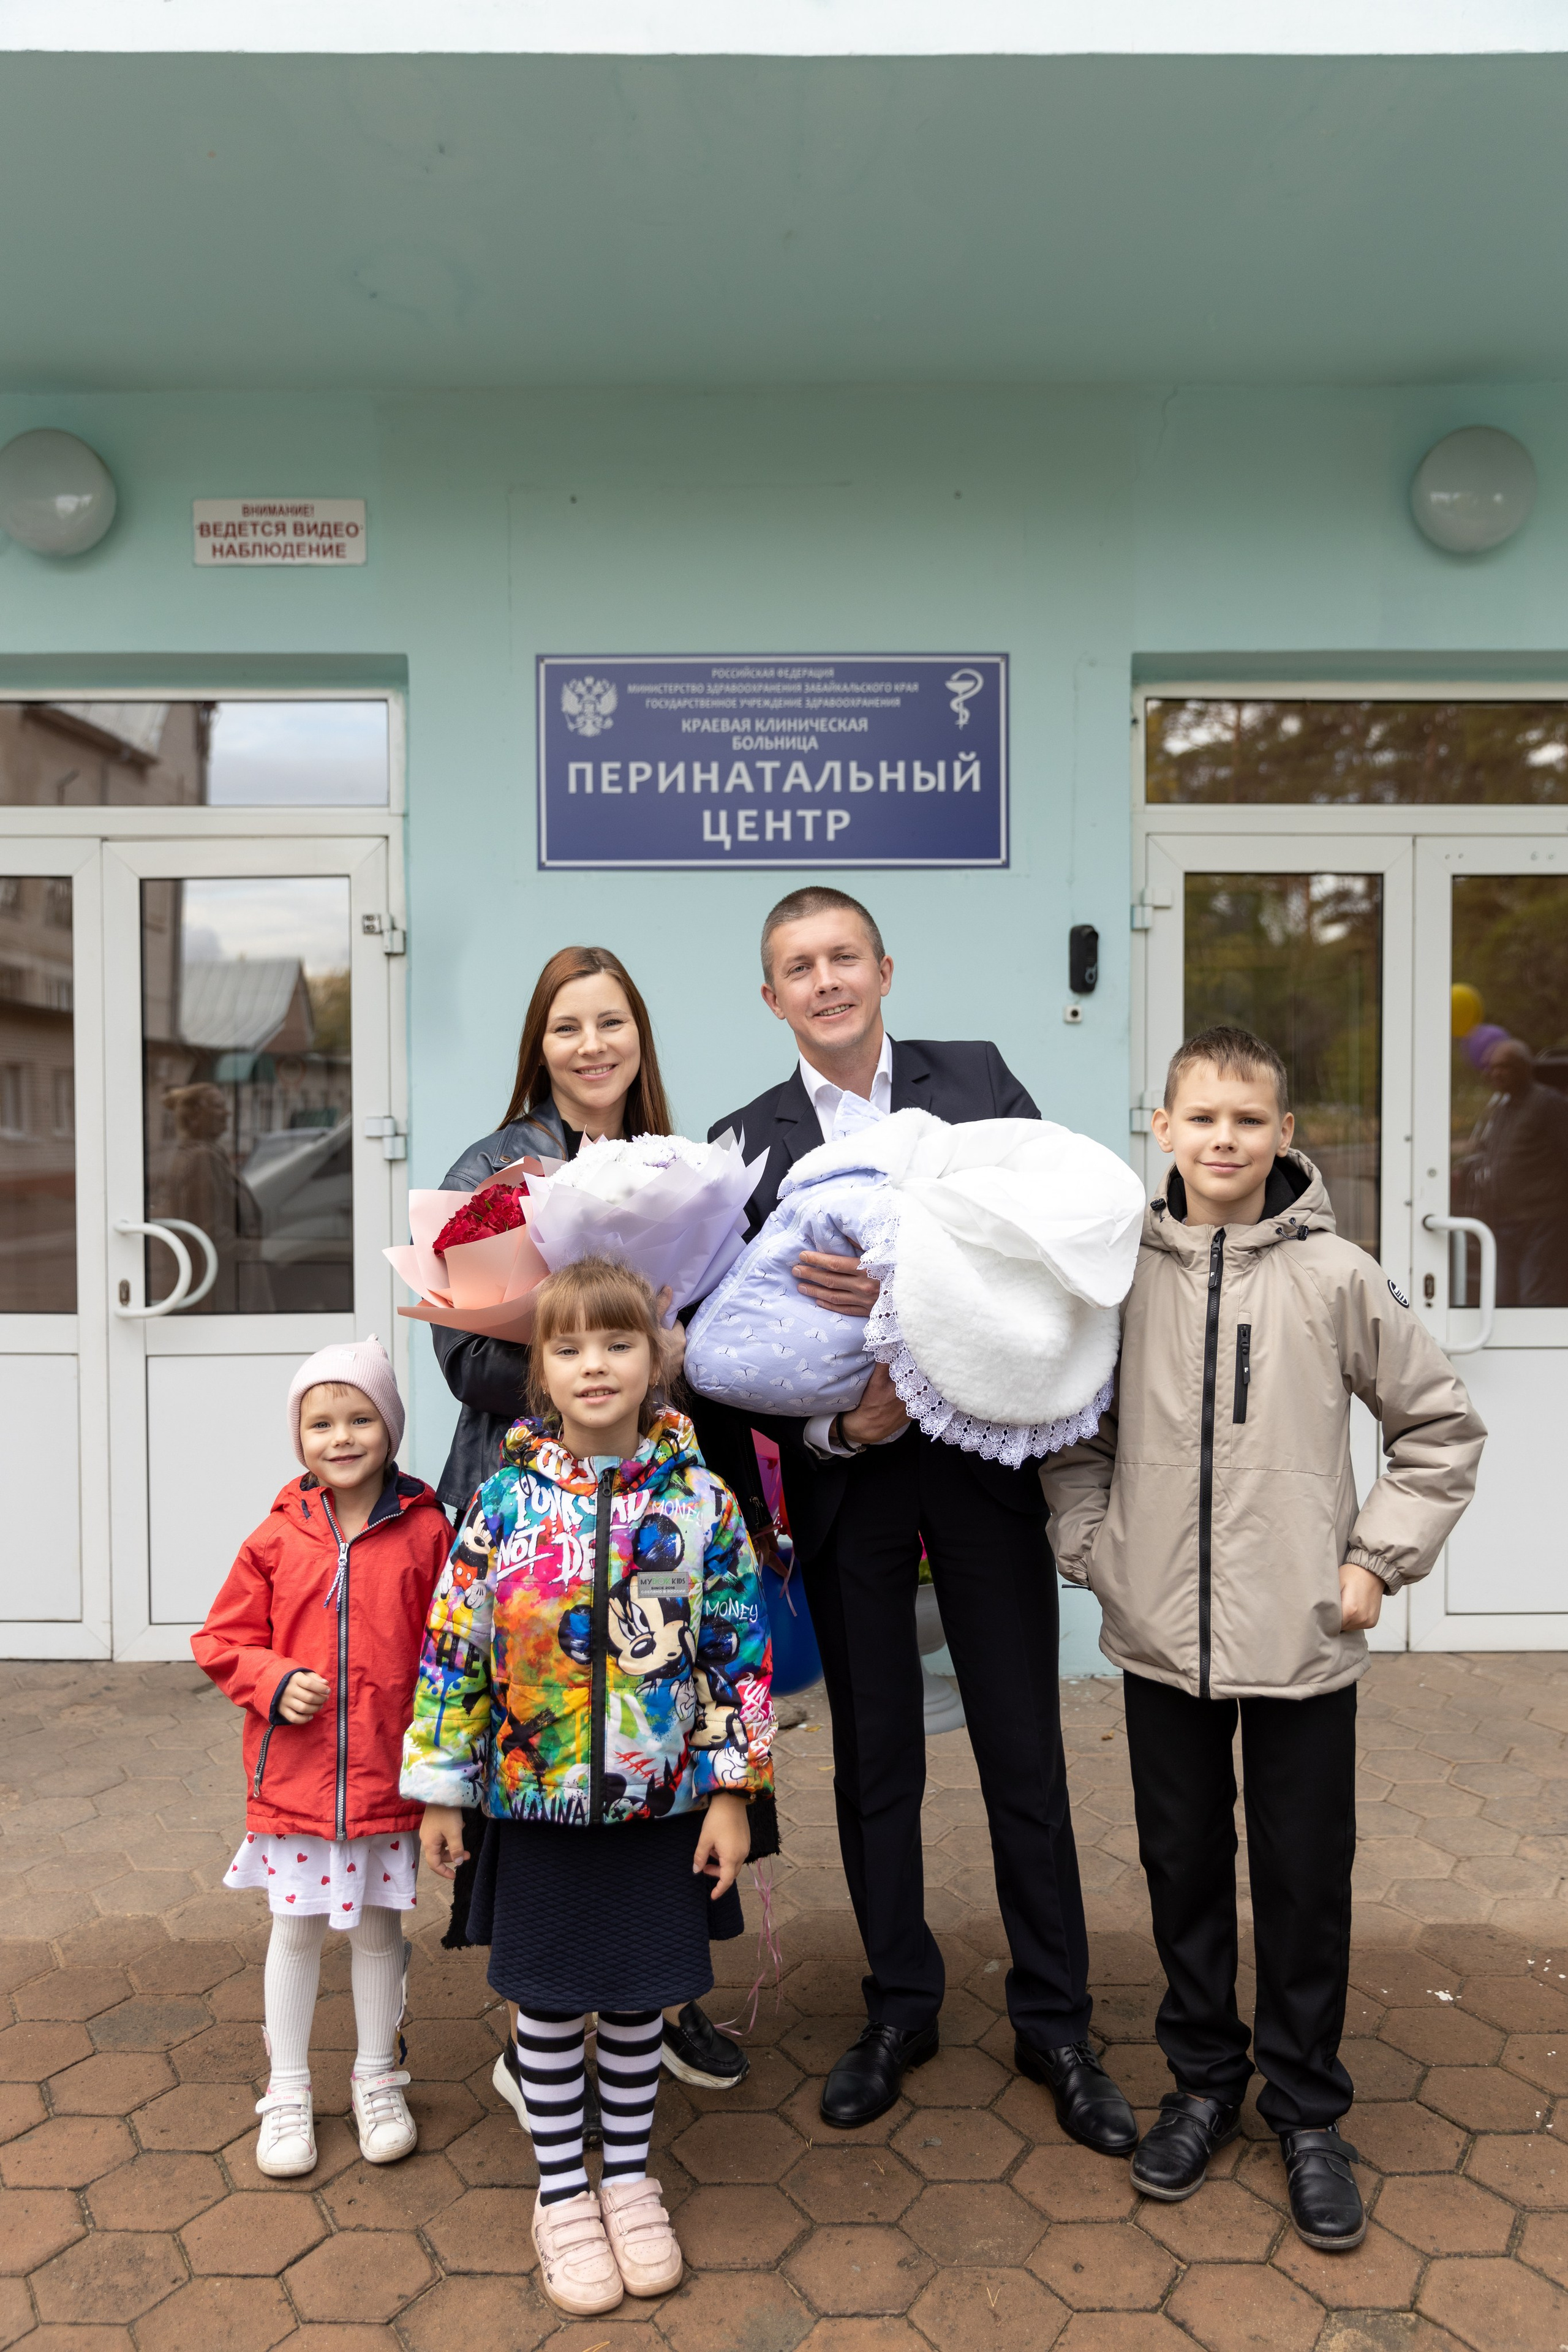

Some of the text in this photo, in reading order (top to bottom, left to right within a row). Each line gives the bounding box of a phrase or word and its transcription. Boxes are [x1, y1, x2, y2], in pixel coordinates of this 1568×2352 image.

[242, 503, 314, 518] ВНИМАНИЕ!
[200, 521, 360, 540] ВЕДЕТСЯ ВИДЕО
[211, 542, 347, 560] НАБЛЮДЕНИЕ
[711, 666, 834, 680] РОССИЙСКАЯ ФЕДЕРАЦИЯ
[627, 680, 919, 695] МИНИСТЕРСТВО ЗДРАВООХРАНЕНИЯ ЗАБАЙКАЛЬСКОГО КРАЯ
[645, 696, 901, 710] ГОСУДАРСТВЕННОЕ УЧРЕЖДЕНИЕ ЗДРАВООХРАНЕНИЯ
[681, 717, 869, 733] КРАЕВАЯ КЛИНИЧЕСКАЯ
[733, 736, 818, 753] БОЛЬНИЦА
[568, 752, 981, 793] ПЕРИНАТАЛЬНЫЙ
[703, 809, 851, 851] ЦЕНТР
[652, 1498, 703, 1527] MONEY
[494, 1525, 546, 1570] NOT
[706, 1597, 758, 1623] MONEY
